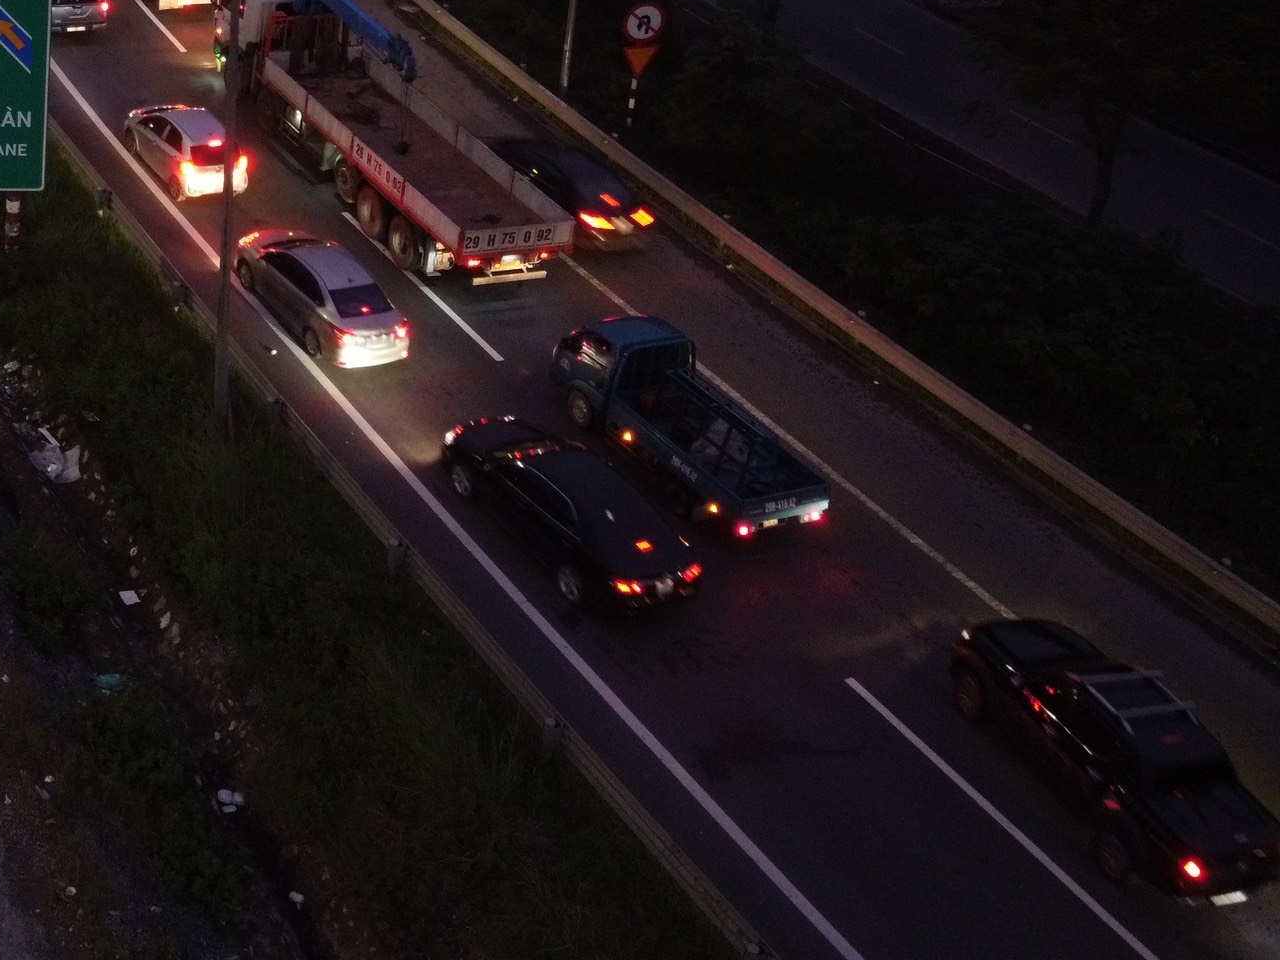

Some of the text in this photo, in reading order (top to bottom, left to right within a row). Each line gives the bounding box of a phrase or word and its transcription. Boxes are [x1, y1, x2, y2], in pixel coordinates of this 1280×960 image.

[355, 143, 364, 159] 29
[366, 152, 372, 166] H
[374, 159, 383, 176] 75
[393, 177, 401, 194] 92
[464, 228, 552, 249] 29 H 75 0 92
